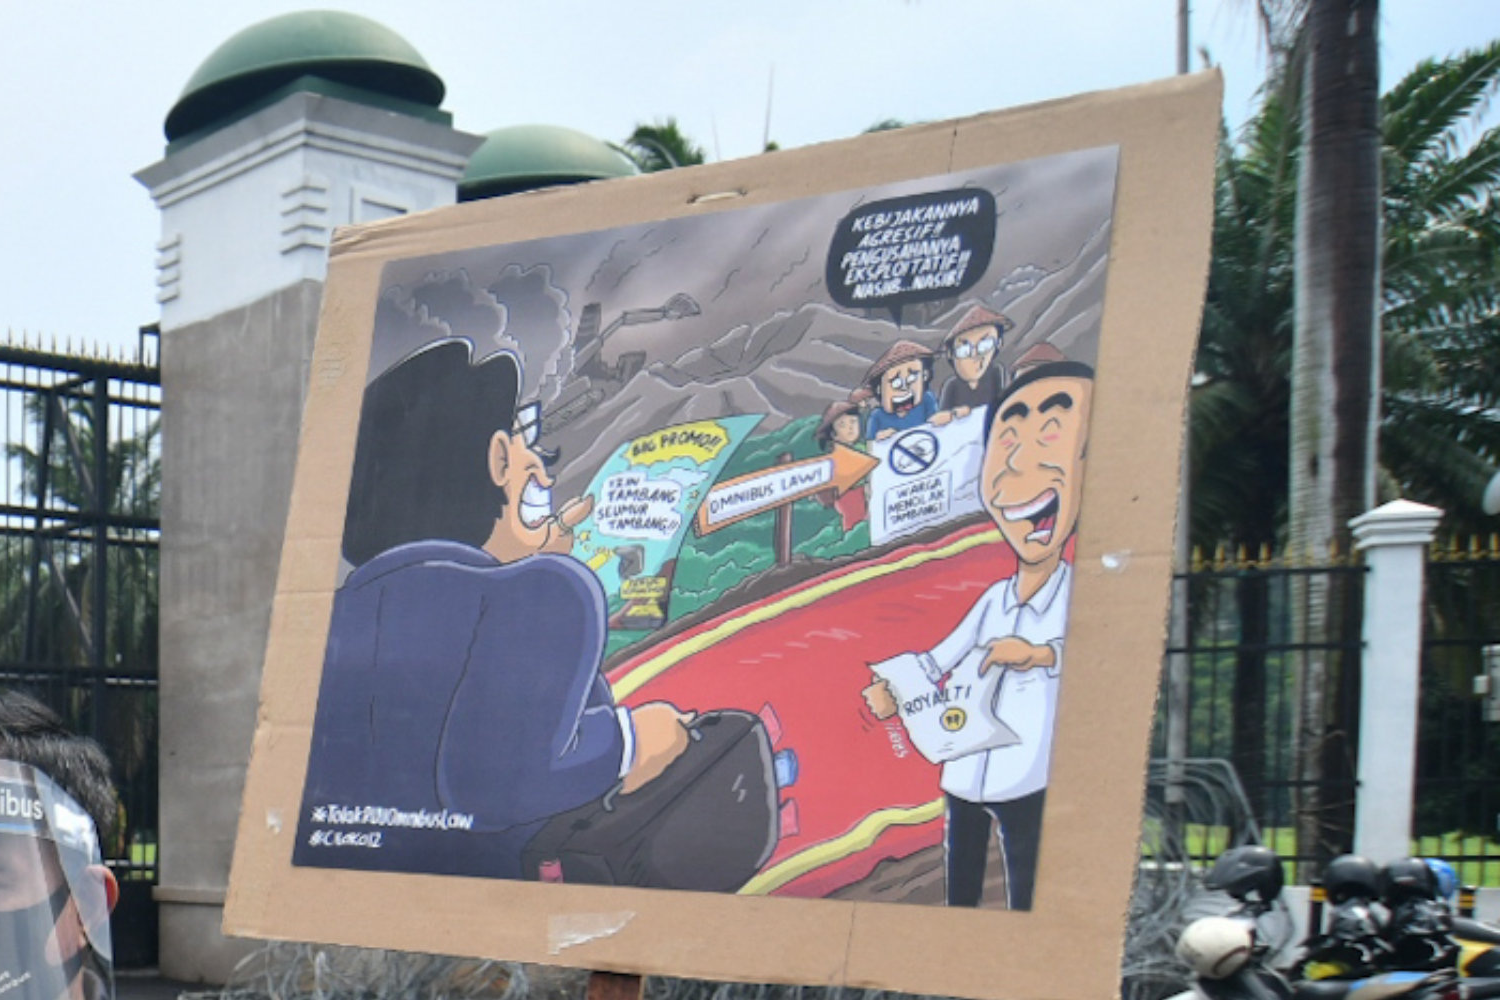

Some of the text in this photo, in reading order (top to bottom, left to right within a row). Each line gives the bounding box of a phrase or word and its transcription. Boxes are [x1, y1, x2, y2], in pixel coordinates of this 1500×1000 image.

[851, 197, 979, 232] KEBIJAKANNYA
[840, 235, 961, 270] PENGUSAHANYA
[632, 440, 657, 457] BIG
[607, 489, 678, 504] TAMBANG
[710, 483, 774, 514] OMNIBUS
[903, 684, 972, 716] ROYALTI
